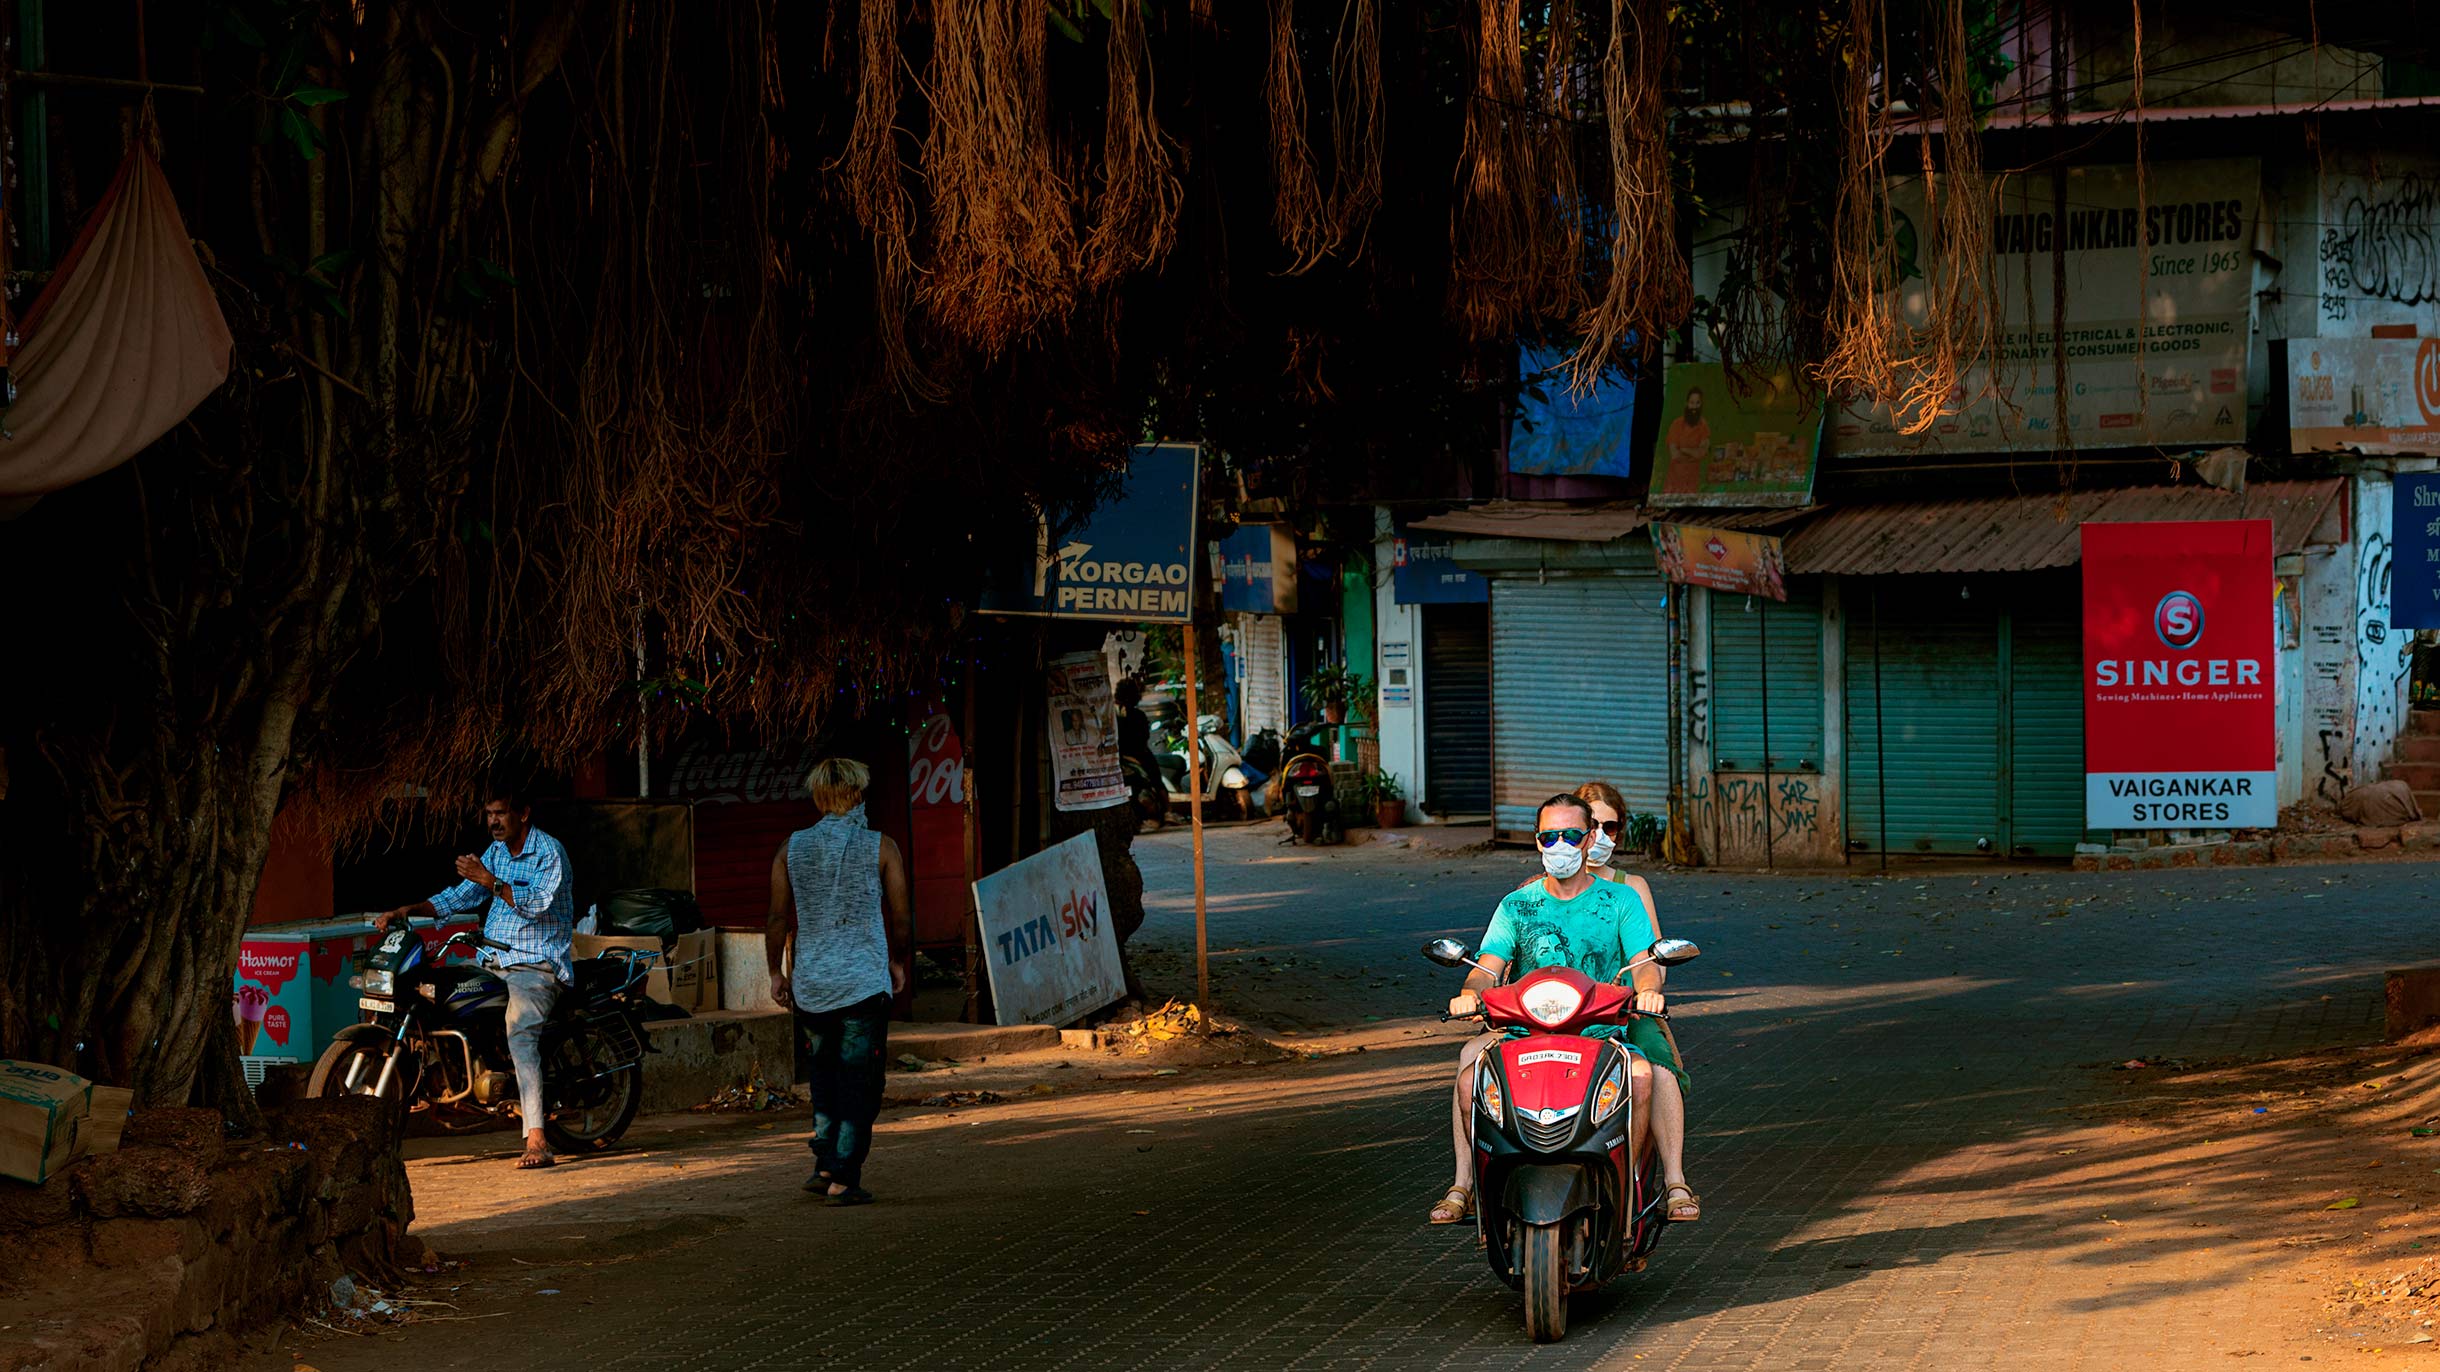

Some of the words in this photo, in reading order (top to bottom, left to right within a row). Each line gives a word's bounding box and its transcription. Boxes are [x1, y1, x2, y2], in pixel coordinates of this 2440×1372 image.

[2145, 199, 2242, 246] STORES
[2150, 254, 2194, 277] Since
[2202, 251, 2241, 274] 1965
[2037, 328, 2122, 344] ELCTRICAL
[2150, 338, 2201, 353] GOODS
[2413, 484, 2440, 507] Shr
[1059, 560, 1188, 585] KORGAO
[1057, 586, 1186, 612] PERNEM
[2166, 605, 2193, 636] S
[2096, 659, 2262, 687] SINGER
[2096, 693, 2130, 703] Sewing
[2131, 692, 2175, 701] Machines
[2182, 691, 2210, 700] Home
[2211, 691, 2263, 702] Appliances
[2109, 778, 2252, 797] VAIGANKAR
[2133, 802, 2230, 822] STORES
[998, 914, 1056, 966] TATA
[1061, 888, 1098, 938] sky
[240, 949, 296, 969] Havmor
[266, 1021, 287, 1029] TASTE
[267, 1014, 286, 1022] PURE
